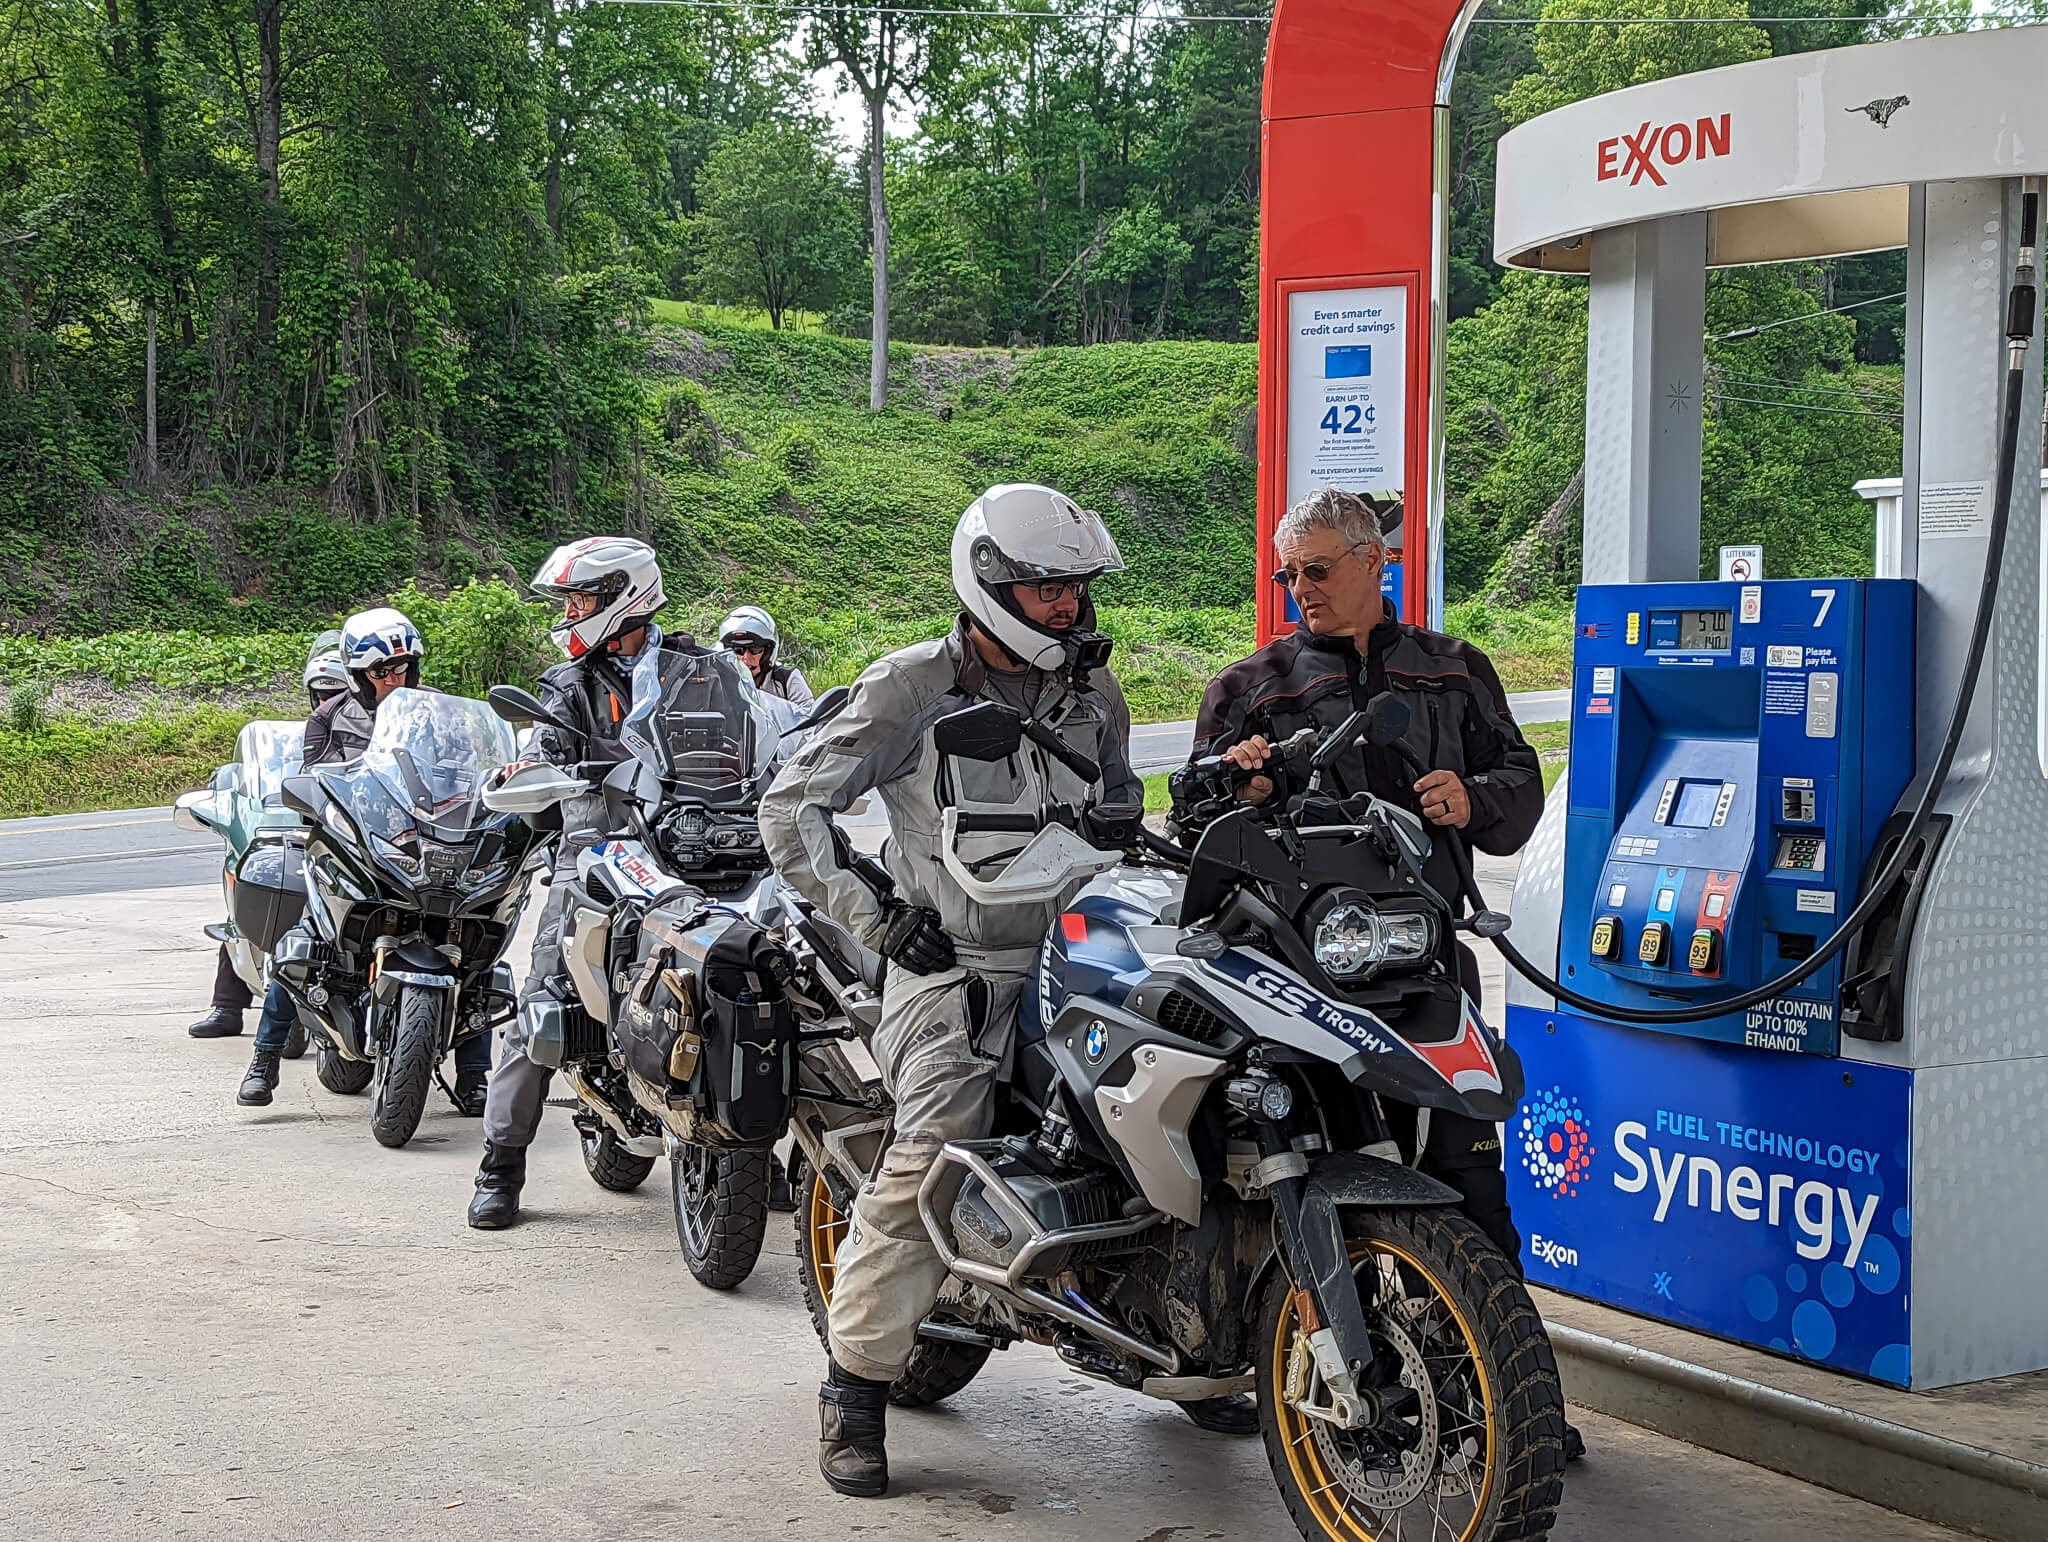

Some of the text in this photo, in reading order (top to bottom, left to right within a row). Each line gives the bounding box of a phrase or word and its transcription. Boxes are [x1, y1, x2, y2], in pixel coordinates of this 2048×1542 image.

[1597, 113, 1732, 187] EXXON
[1314, 308, 1382, 320] Even smarter
[1301, 321, 1395, 336] credit card savings
[1325, 395, 1346, 403] EARN
[1327, 467, 1357, 475] EVERYDAY
[1358, 466, 1384, 474] SAVINGS
[1811, 589, 1836, 628] 7
[1805, 657, 1820, 667] pay
[1821, 655, 1838, 665] first
[1806, 647, 1832, 657] Please
[1594, 932, 1609, 946] 87
[1642, 938, 1657, 953] 89
[1692, 945, 1708, 959] 93
[1246, 970, 1394, 1054] GS TROPHY
[1776, 1000, 1832, 1021] CONTAIN
[1746, 1012, 1807, 1036] UP TO 10%
[1745, 1030, 1804, 1053] ETHANOL
[1655, 1109, 1880, 1176] FUEL TECHNOLOGY
[1613, 1120, 1880, 1269] Synergy
[1530, 1234, 1578, 1269] Exxon
